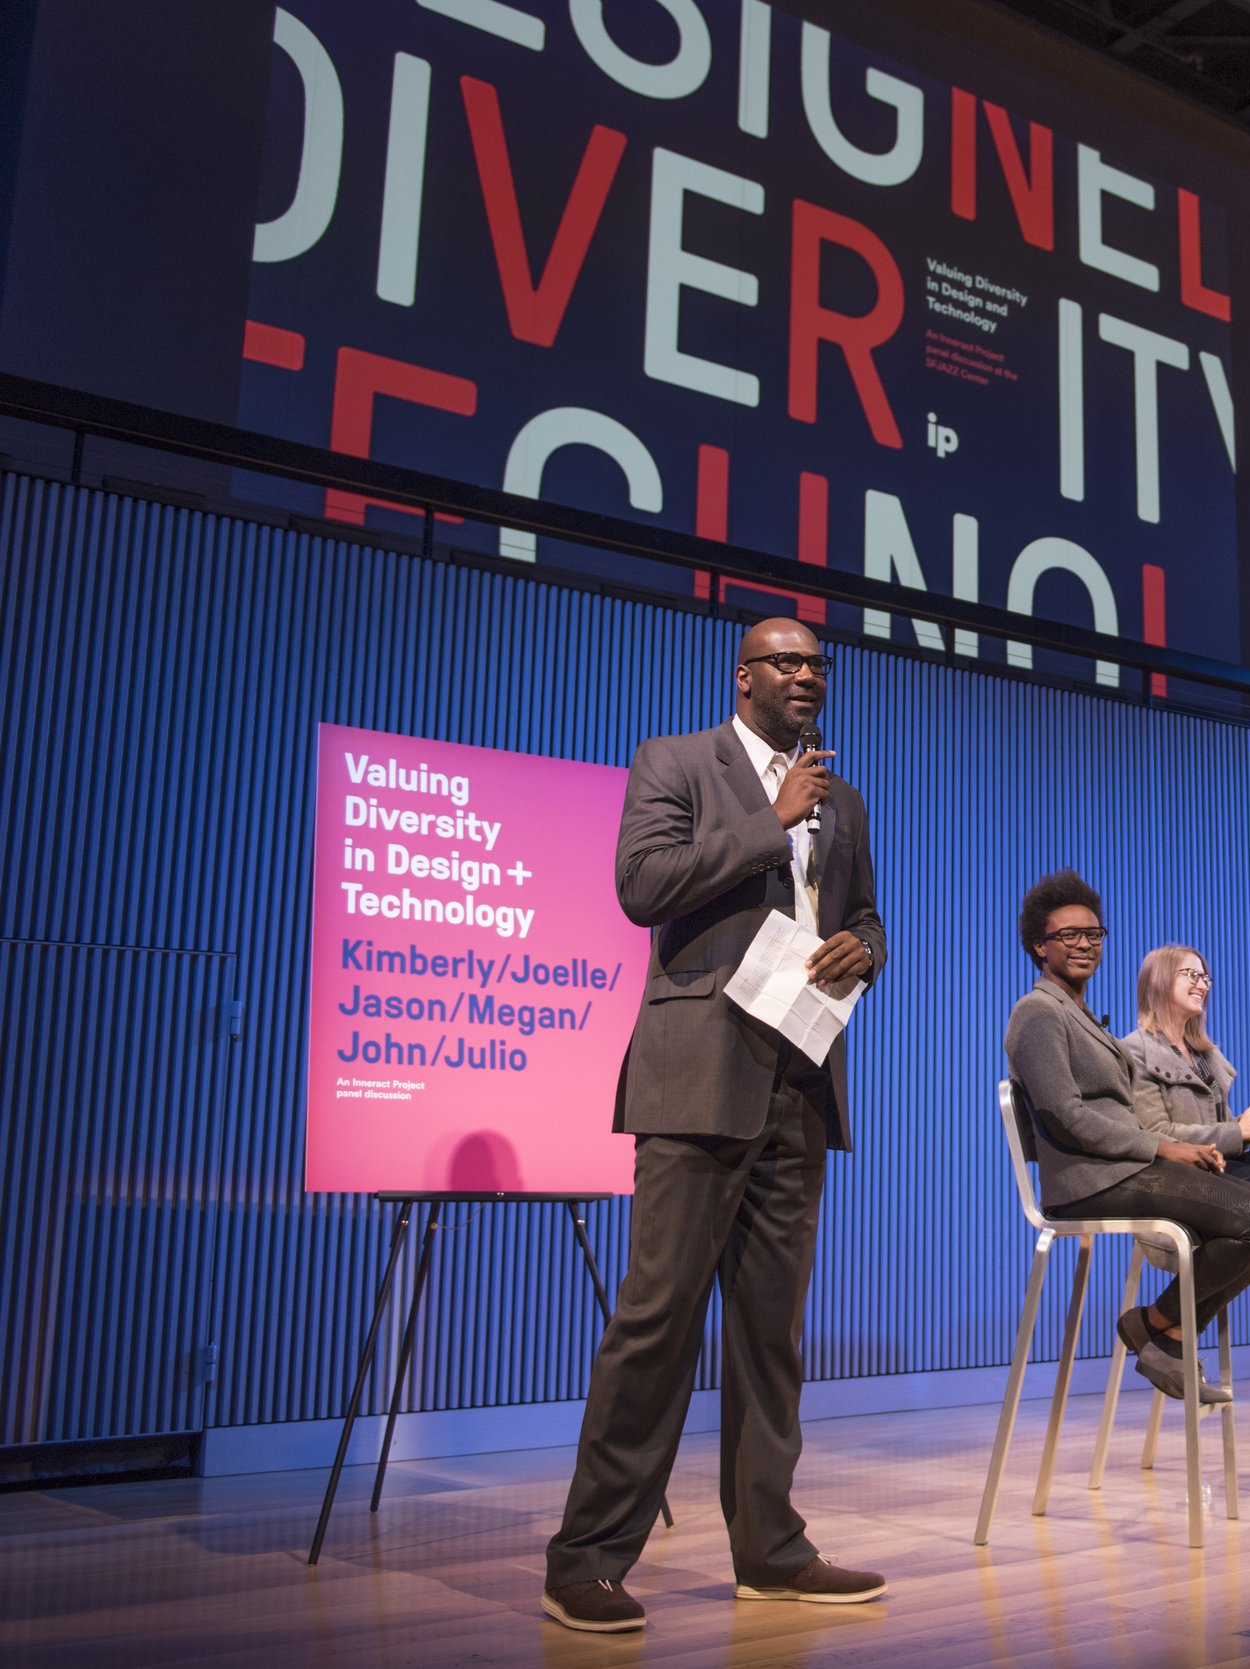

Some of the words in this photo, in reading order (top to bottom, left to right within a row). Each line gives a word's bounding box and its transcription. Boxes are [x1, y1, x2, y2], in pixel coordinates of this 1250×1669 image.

[926, 257, 973, 288] Valuing
[975, 275, 1027, 307] Diversity
[926, 276, 939, 292] in
[941, 282, 983, 308] Design
[985, 301, 1008, 317] and
[926, 295, 997, 333] Technology
[927, 412, 959, 458] ip
[344, 752, 470, 806] Valuing
[345, 795, 502, 851] Diversity
[344, 838, 375, 872] in
[341, 882, 535, 939] Technology
[337, 1031, 527, 1072] John/Julio
[336, 1077, 350, 1087] An
[352, 1078, 391, 1089] Inneract
[392, 1079, 425, 1091] Project
[336, 1089, 362, 1099] panel
[364, 1089, 412, 1100] discussion
